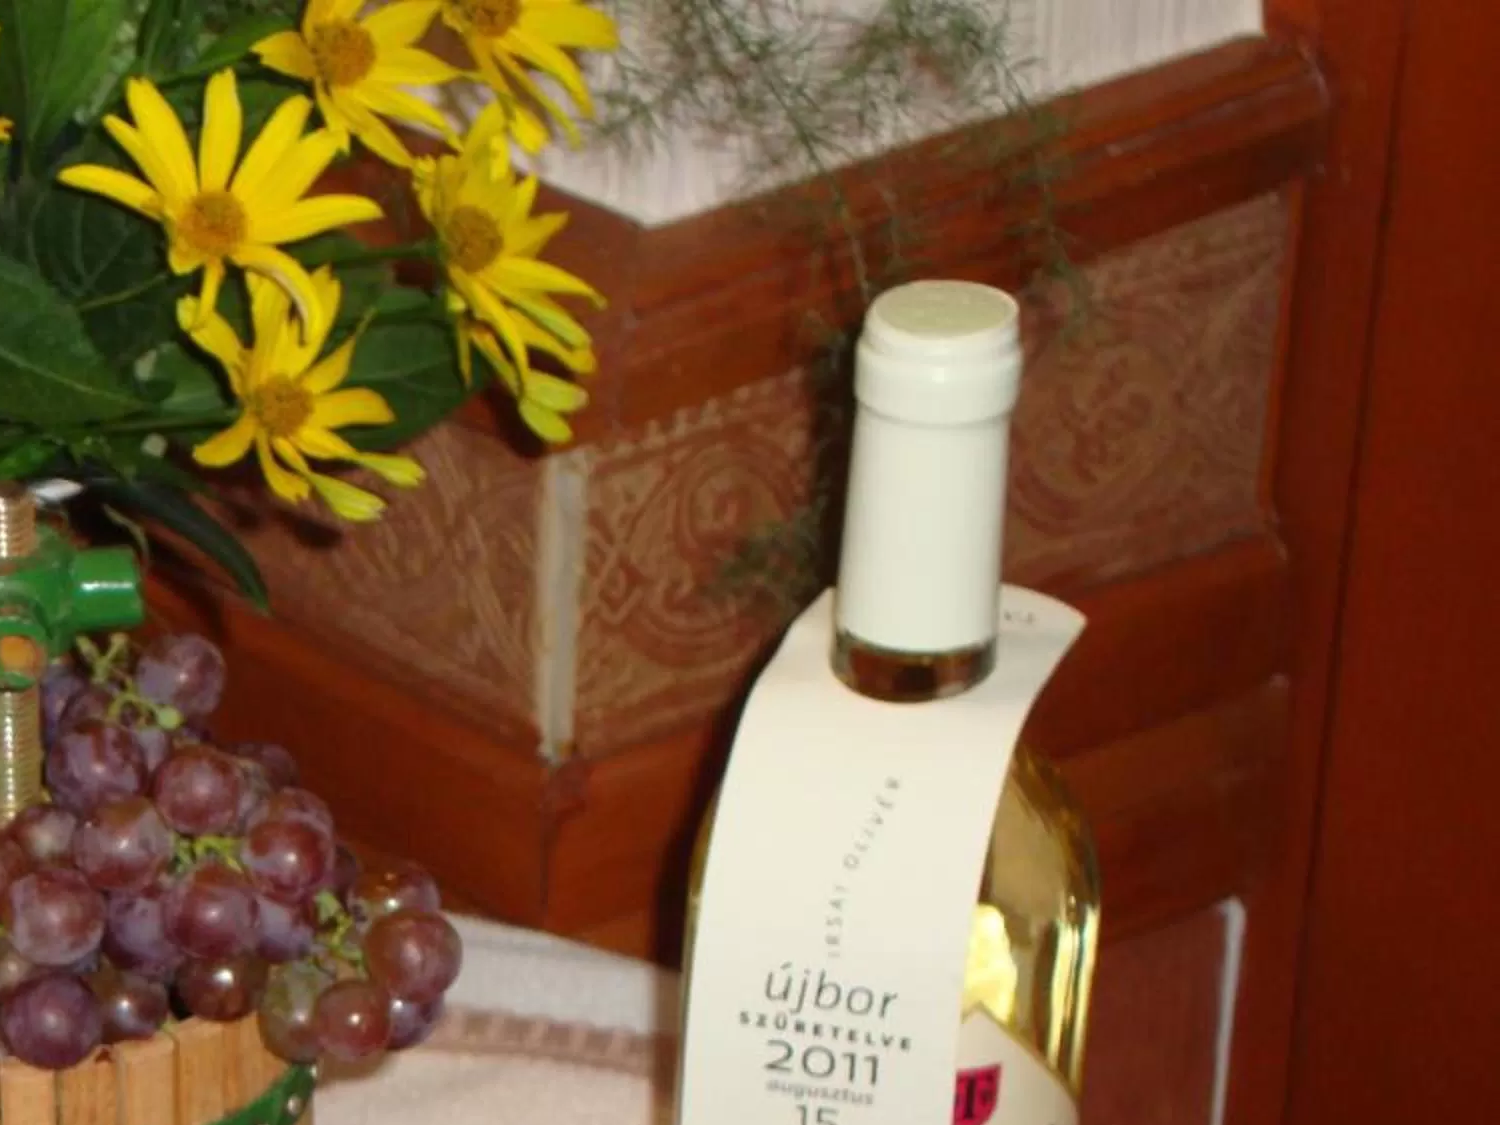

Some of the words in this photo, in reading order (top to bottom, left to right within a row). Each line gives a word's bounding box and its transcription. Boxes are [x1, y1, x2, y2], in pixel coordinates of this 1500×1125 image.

[765, 961, 898, 1019] újbor
[764, 1039, 879, 1086] 2011
[766, 1080, 874, 1105] augusztus
